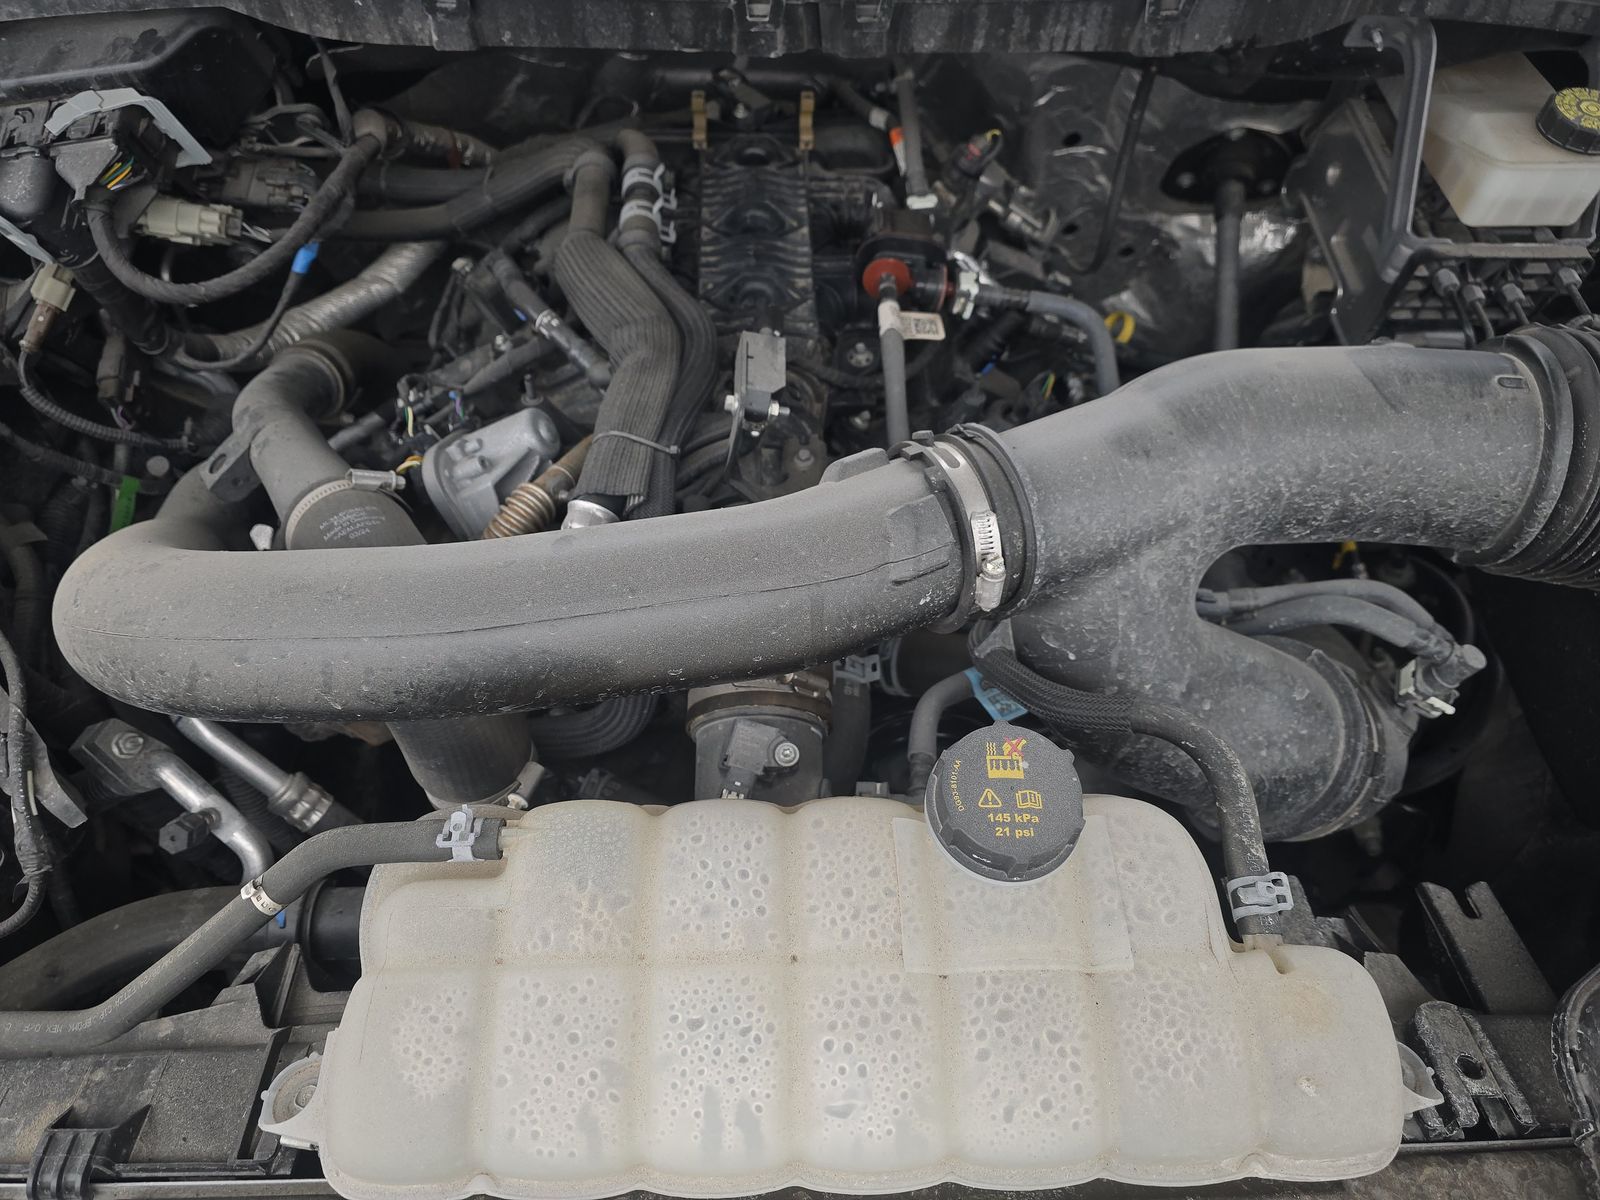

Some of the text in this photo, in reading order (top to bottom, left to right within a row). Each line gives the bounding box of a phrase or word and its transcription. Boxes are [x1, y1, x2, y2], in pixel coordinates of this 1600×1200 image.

[987, 812, 1040, 824] 145 kPa
[995, 826, 1035, 839] 21 psi
